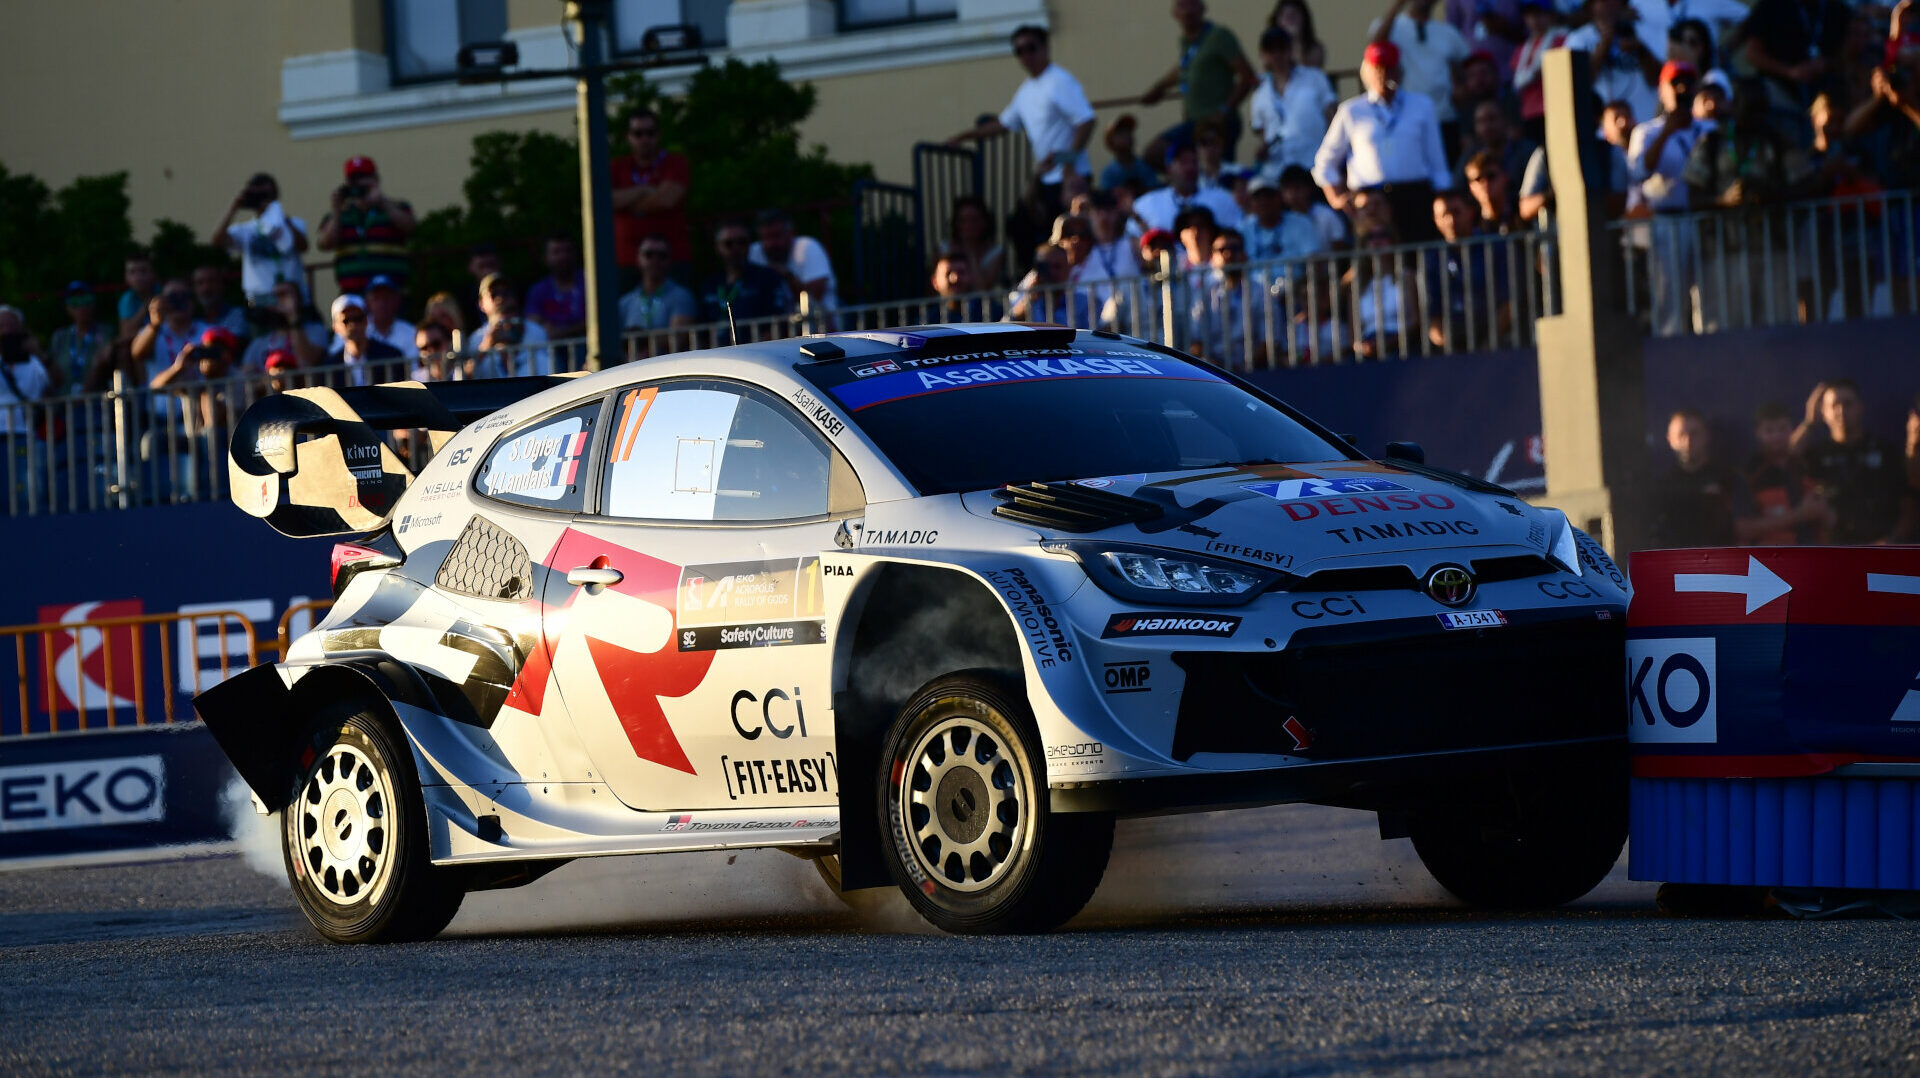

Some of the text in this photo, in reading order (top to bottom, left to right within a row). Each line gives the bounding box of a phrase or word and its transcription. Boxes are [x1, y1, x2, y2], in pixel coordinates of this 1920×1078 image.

[903, 351, 998, 367] TOYOTA
[921, 358, 1164, 390] AsahiKASEI
[610, 387, 659, 463] 17
[791, 387, 846, 438] AsahiKASEI
[422, 480, 463, 496] NISULA
[410, 512, 443, 528] Microsoft
[1279, 493, 1456, 523] DENSO
[866, 530, 939, 545] TAMADIC
[1326, 520, 1480, 545] TAMADIC
[823, 565, 855, 577] PIAA
[735, 582, 775, 594] ACROPOLIS
[983, 570, 1056, 669] AUTOMOTIVE
[1002, 567, 1073, 662] Panasonic
[1454, 612, 1496, 626] A-7541
[1104, 667, 1150, 688] OMP
[1628, 652, 1711, 729] KO
[1, 767, 157, 821] EKO
